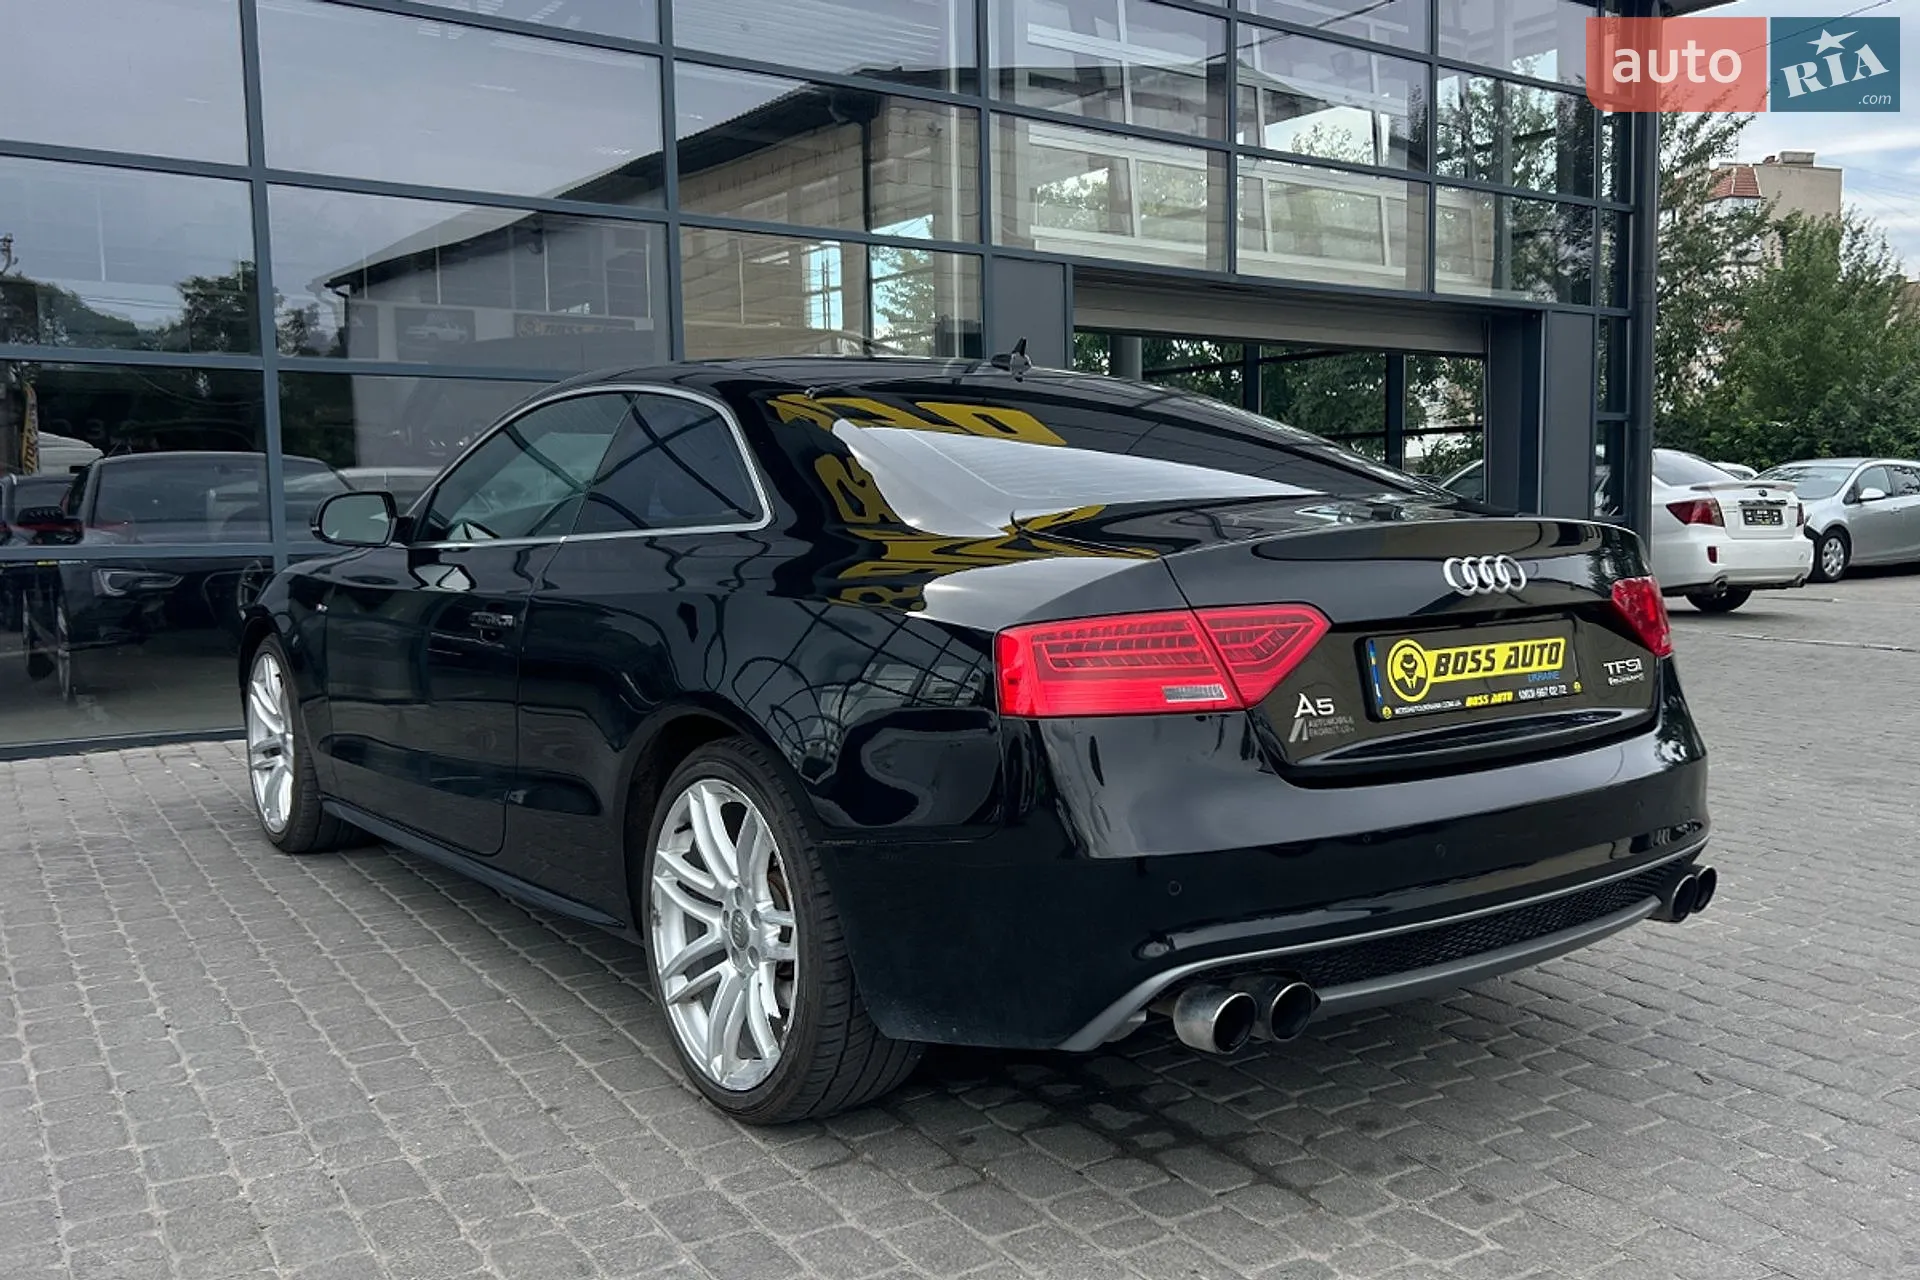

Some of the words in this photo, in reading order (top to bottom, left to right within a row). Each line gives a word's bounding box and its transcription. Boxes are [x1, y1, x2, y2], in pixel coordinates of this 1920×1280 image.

[1434, 649, 1496, 678] BOSS
[1503, 642, 1562, 670] AUTO
[1603, 658, 1643, 675] TFSI
[1294, 693, 1335, 718] A5
[1465, 694, 1489, 707] BOSS
[1491, 691, 1513, 704] AUTO
